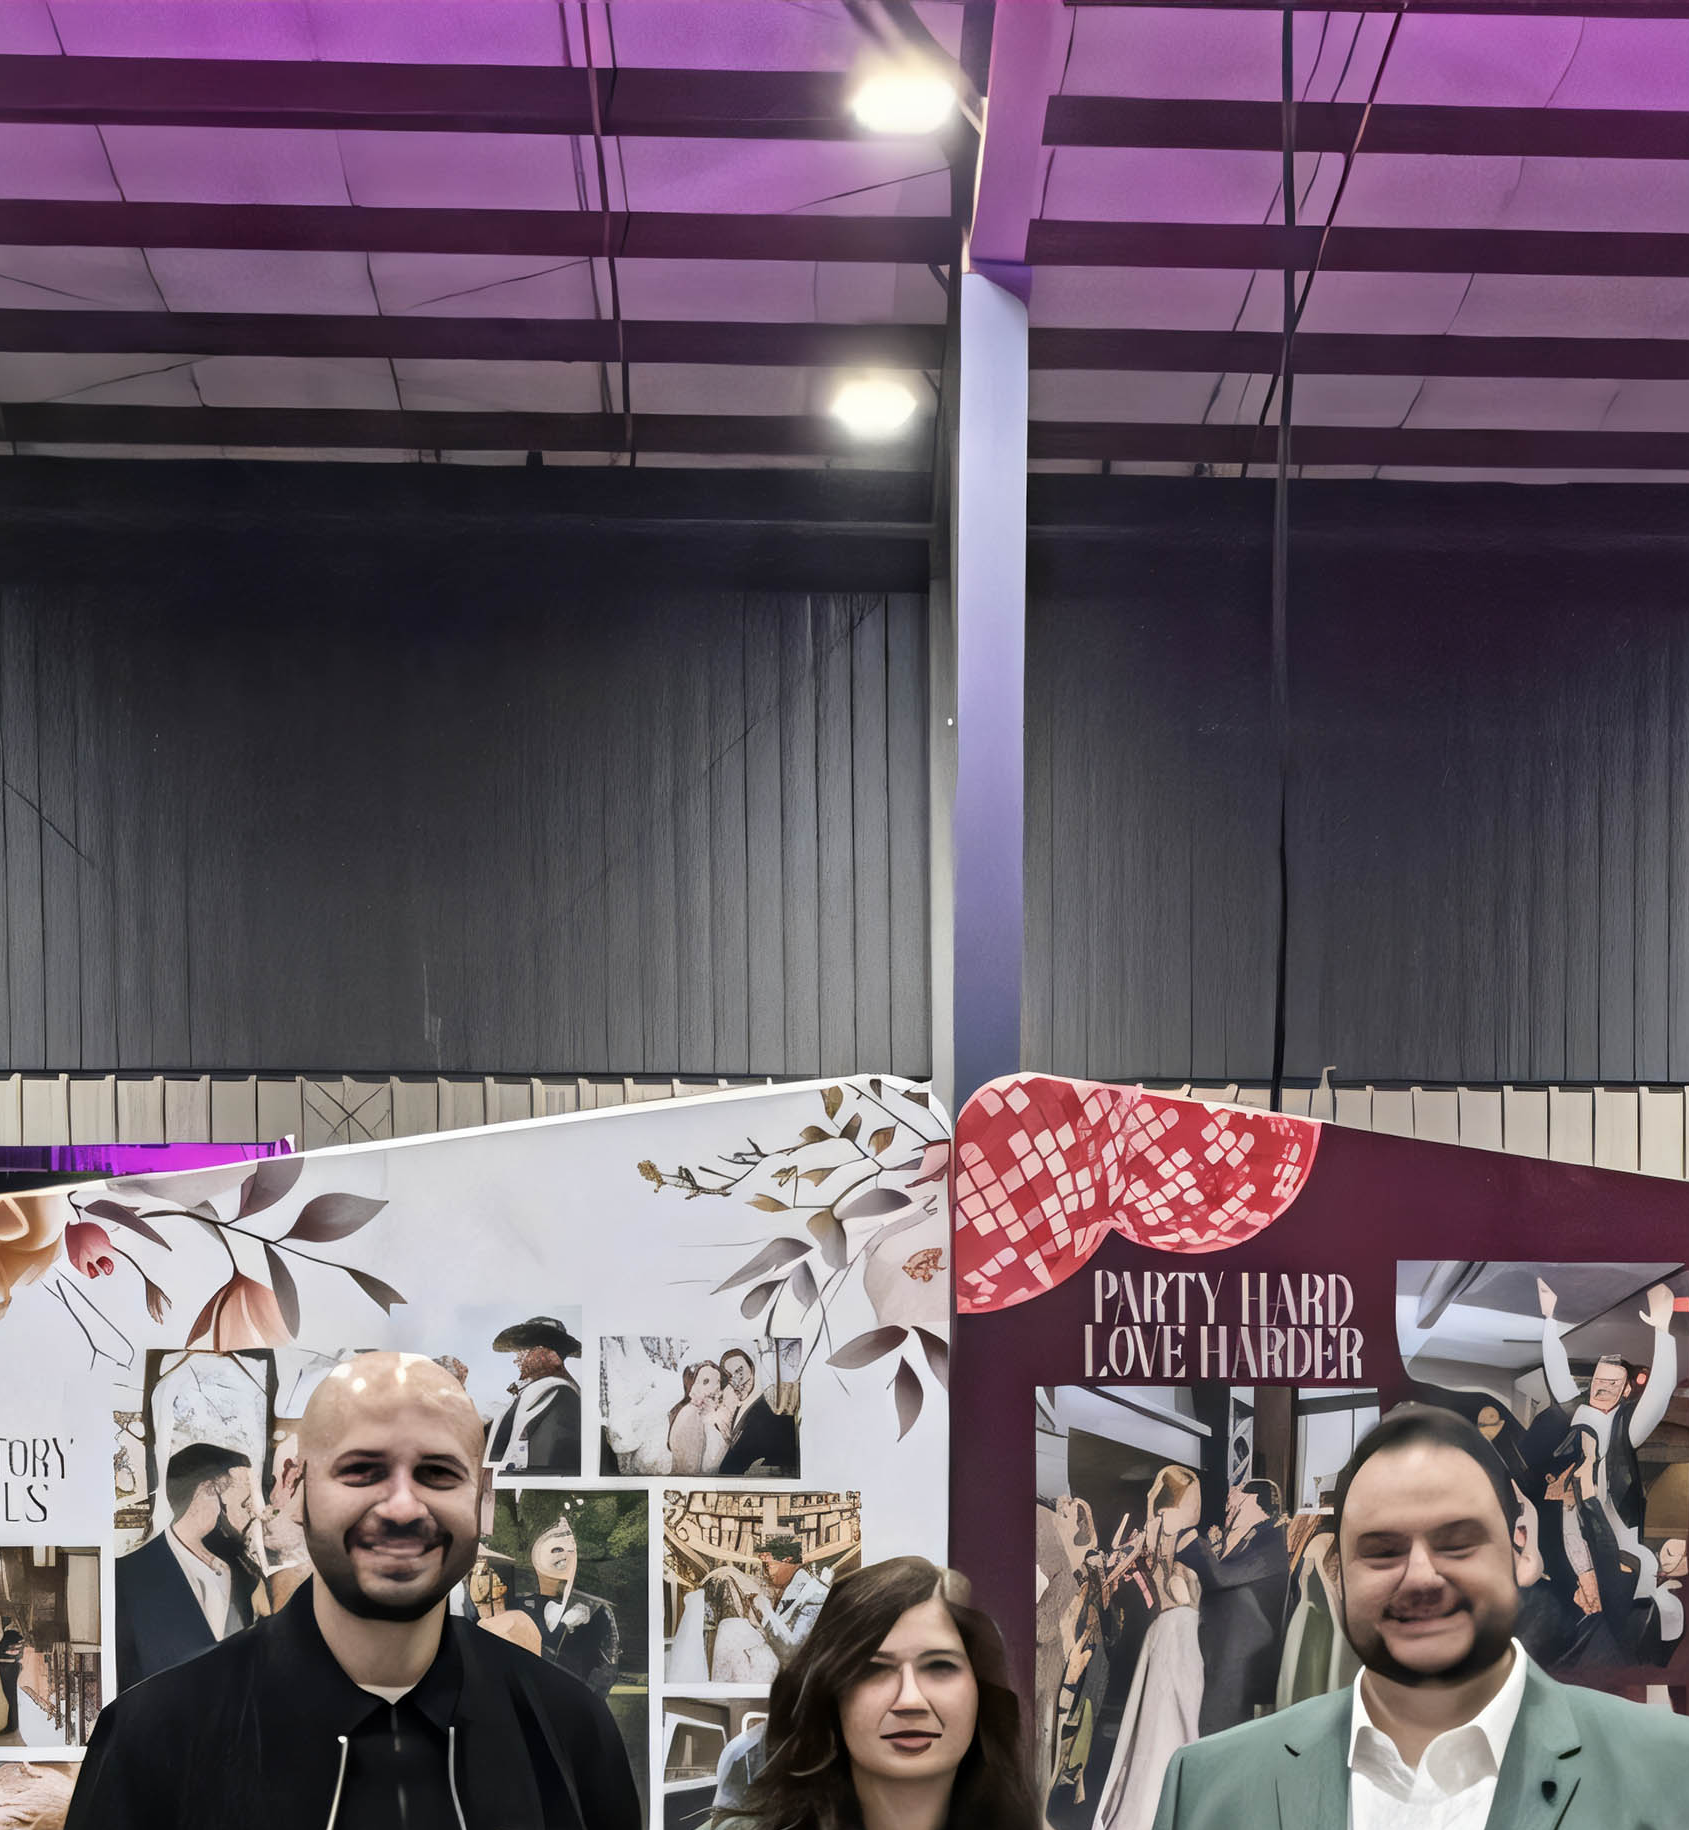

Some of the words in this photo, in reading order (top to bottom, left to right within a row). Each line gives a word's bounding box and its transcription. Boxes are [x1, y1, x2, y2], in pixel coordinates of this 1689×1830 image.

[1094, 1269, 1224, 1325] PARTY
[1241, 1271, 1354, 1327] HARD
[1084, 1323, 1187, 1379] LOVE
[1199, 1325, 1365, 1379] HARDER
